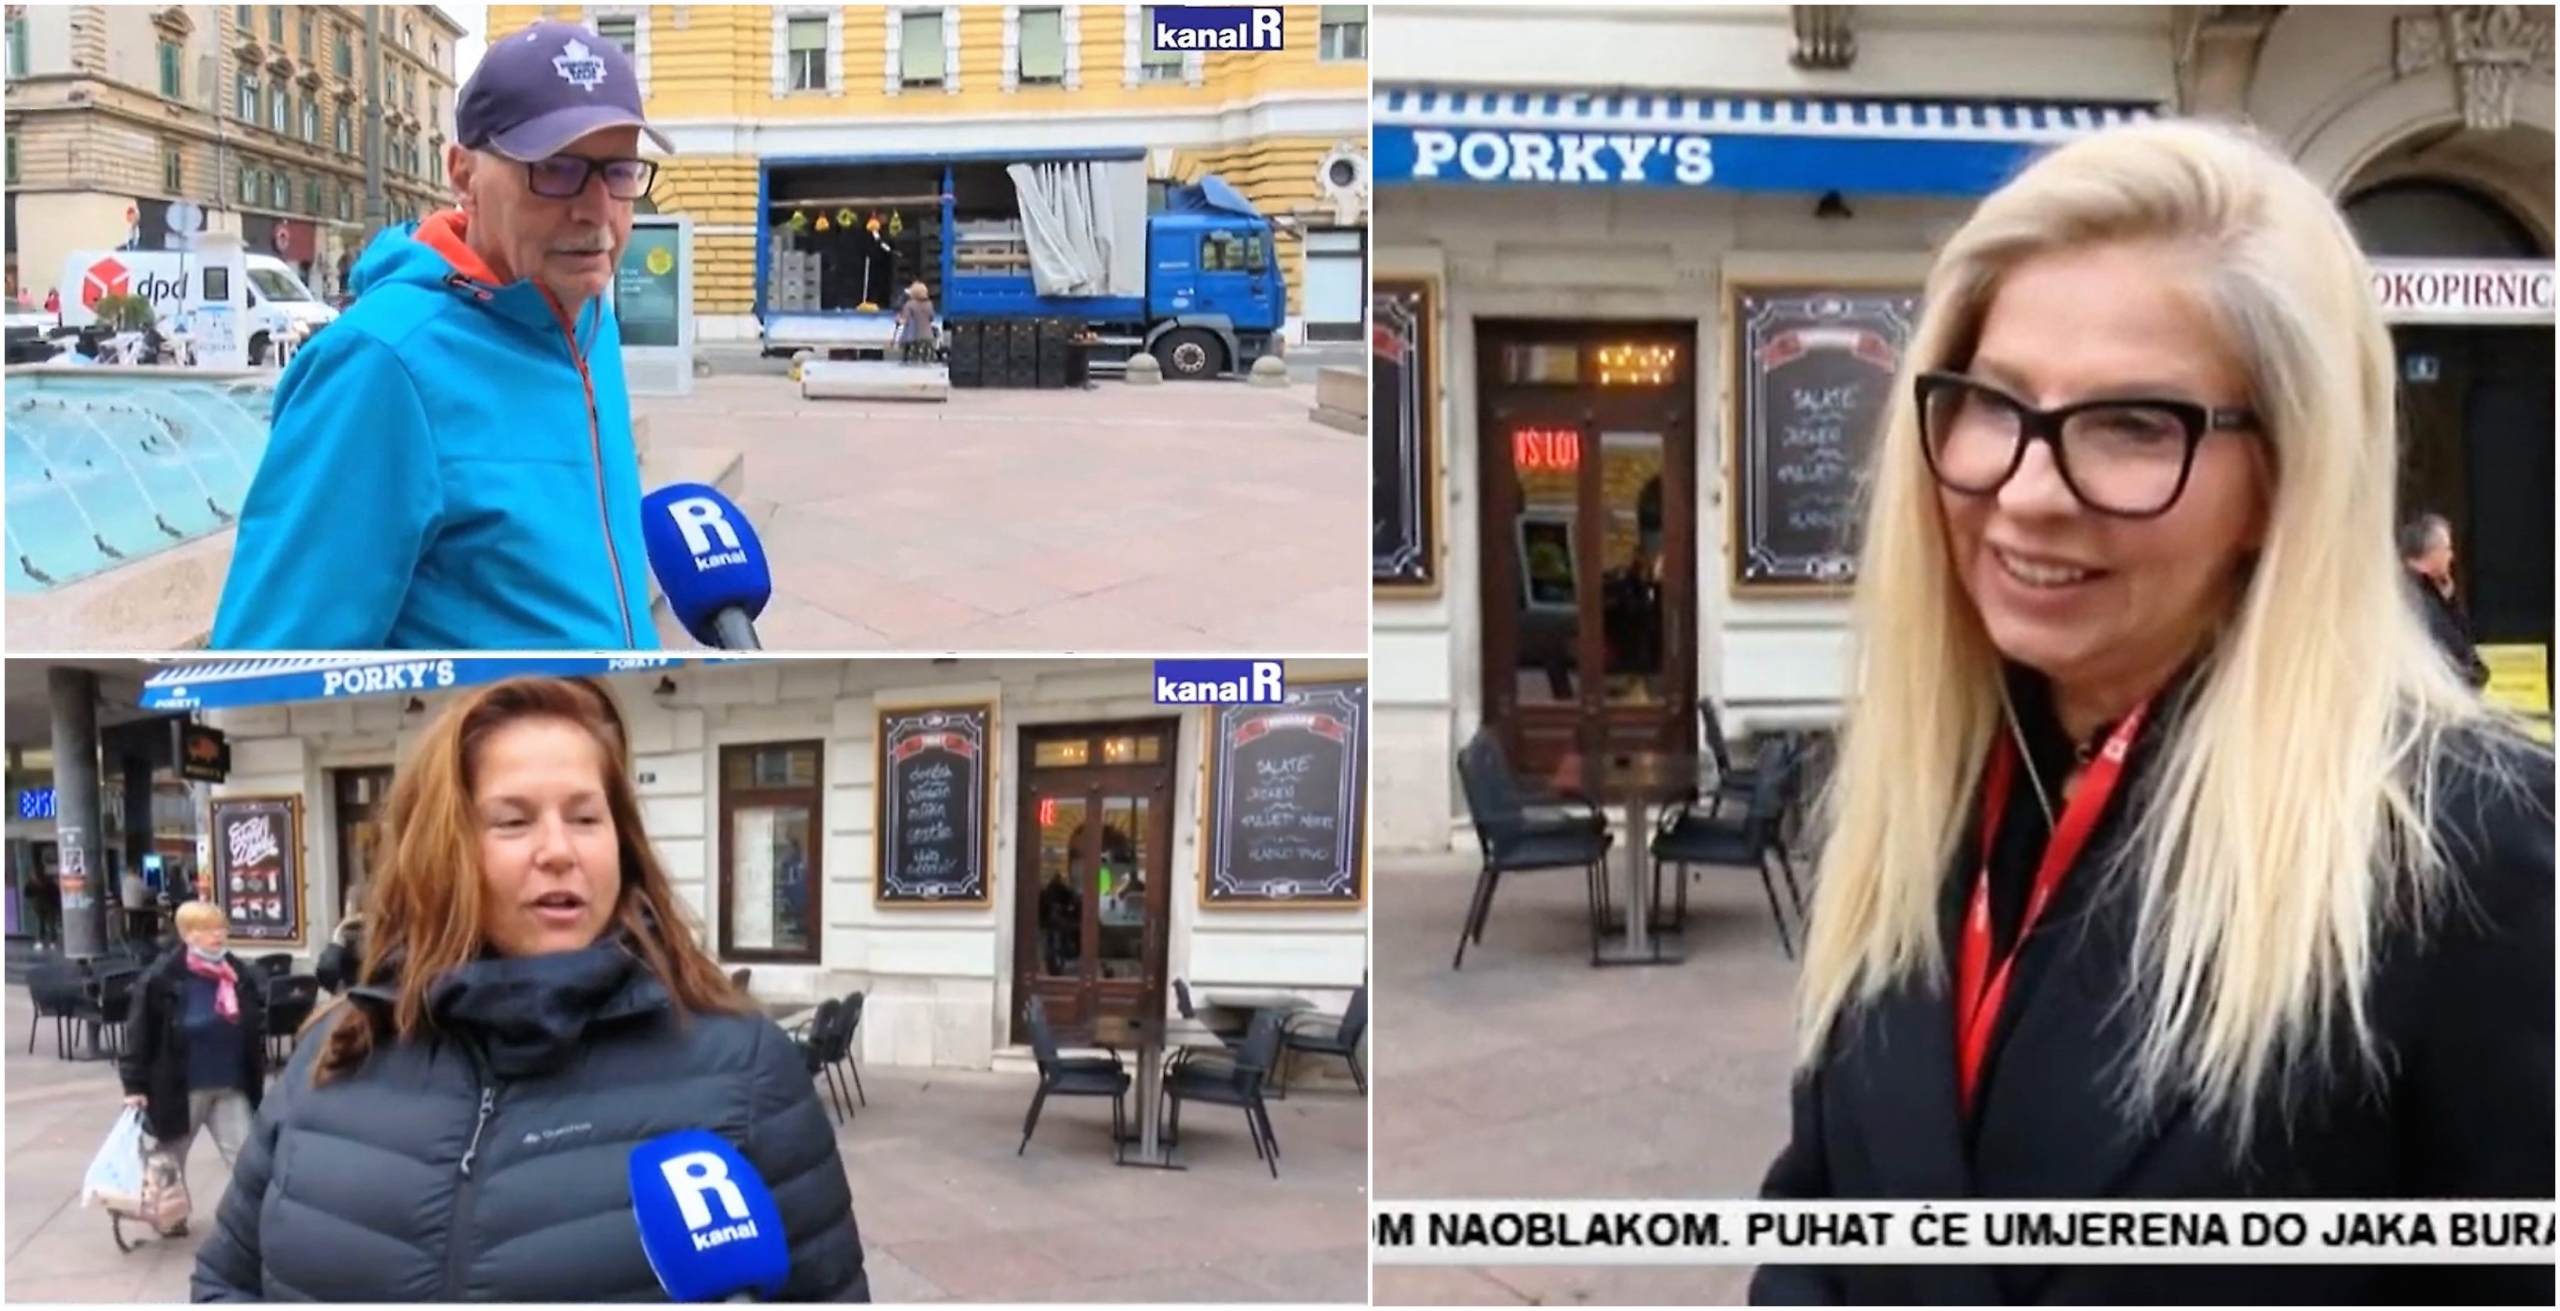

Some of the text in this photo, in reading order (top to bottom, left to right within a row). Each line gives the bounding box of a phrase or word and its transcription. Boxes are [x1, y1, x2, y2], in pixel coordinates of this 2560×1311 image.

[1412, 130, 1714, 183] PORKY'S
[137, 270, 189, 305] dpd
[2373, 272, 2556, 308] OKOPIRNIC
[667, 497, 741, 556] R
[694, 549, 748, 572] kanal
[323, 659, 455, 696] PORKY'S
[659, 1151, 750, 1231] R
[691, 1218, 758, 1252] kanal
